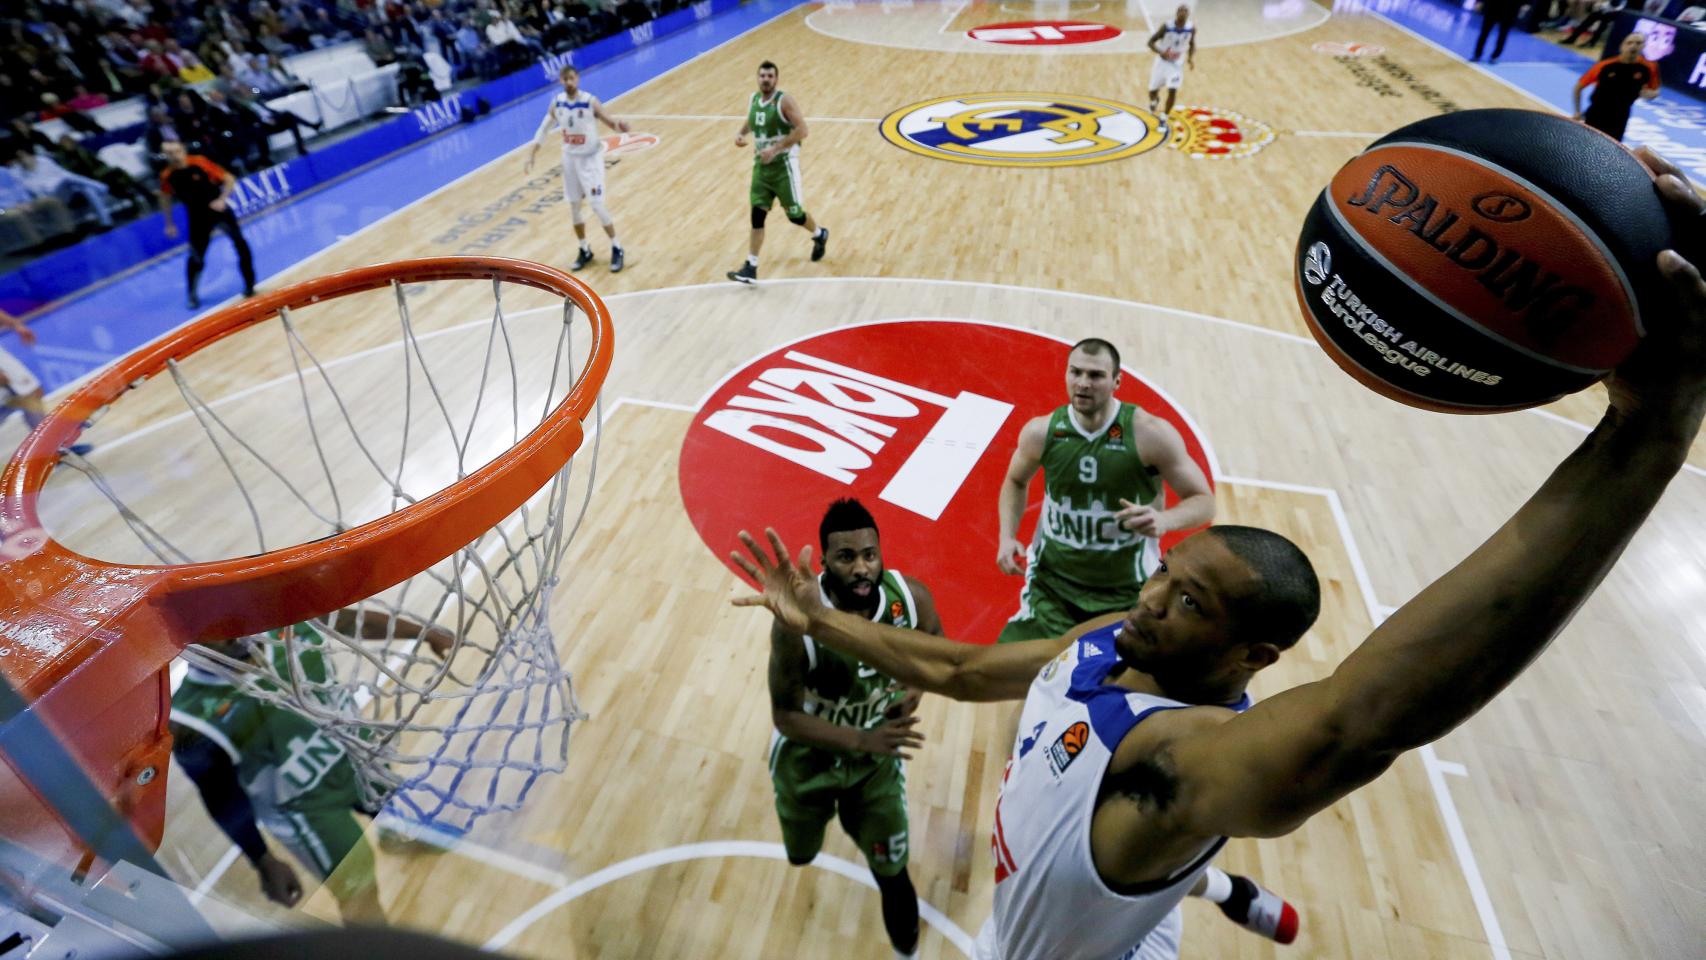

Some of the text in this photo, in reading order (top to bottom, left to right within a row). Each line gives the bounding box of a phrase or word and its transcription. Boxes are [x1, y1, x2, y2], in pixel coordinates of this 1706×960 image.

[1347, 164, 1596, 346] SPALDING
[1320, 286, 1432, 377] EuroLeague
[1332, 273, 1504, 386] TURKISH AIRLINES
[1078, 455, 1098, 483] 9
[888, 831, 907, 863] 5
